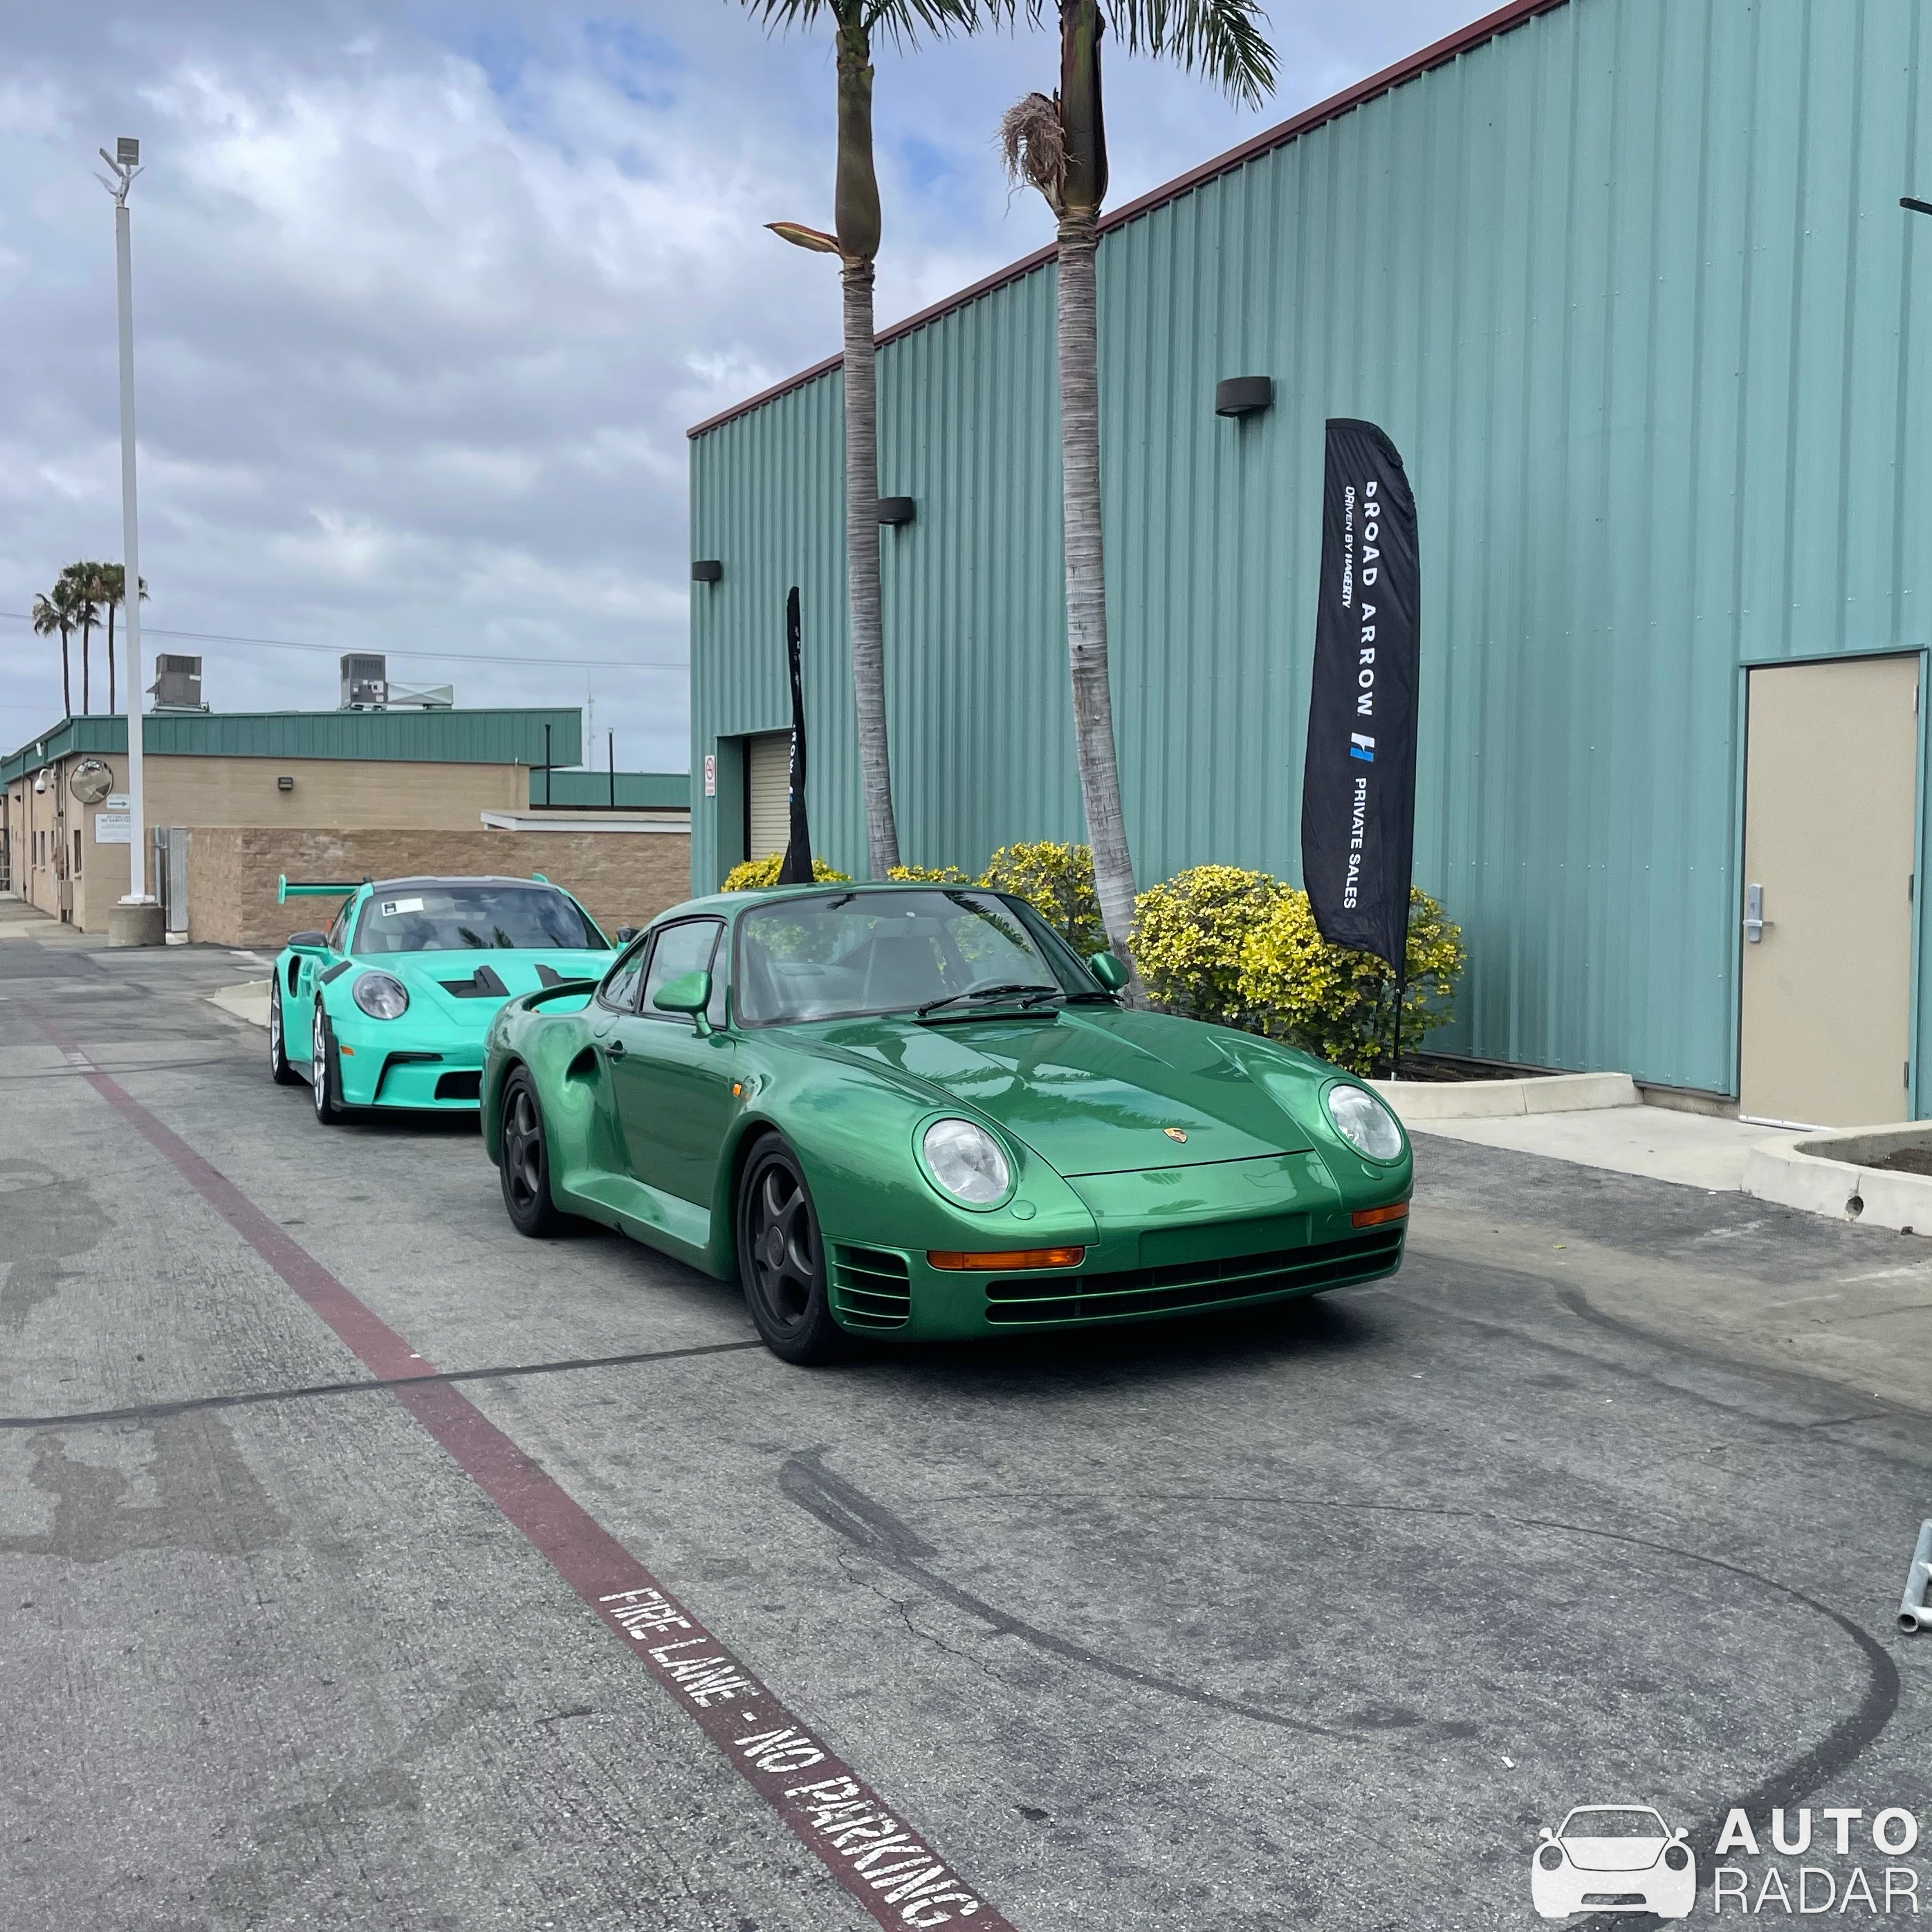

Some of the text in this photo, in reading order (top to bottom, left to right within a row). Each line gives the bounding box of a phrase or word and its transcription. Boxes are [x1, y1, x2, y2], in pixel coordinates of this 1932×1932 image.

[1344, 486, 1355, 531] DRIVEN
[1345, 533, 1353, 552] BY
[1356, 602, 1377, 716] ARROW
[1343, 778, 1367, 909] PRIVATE SALES
[599, 1588, 692, 1639] FIRE
[648, 1637, 760, 1708] LANE
[734, 1726, 825, 1772] NO
[784, 1776, 979, 1928] PARKING
